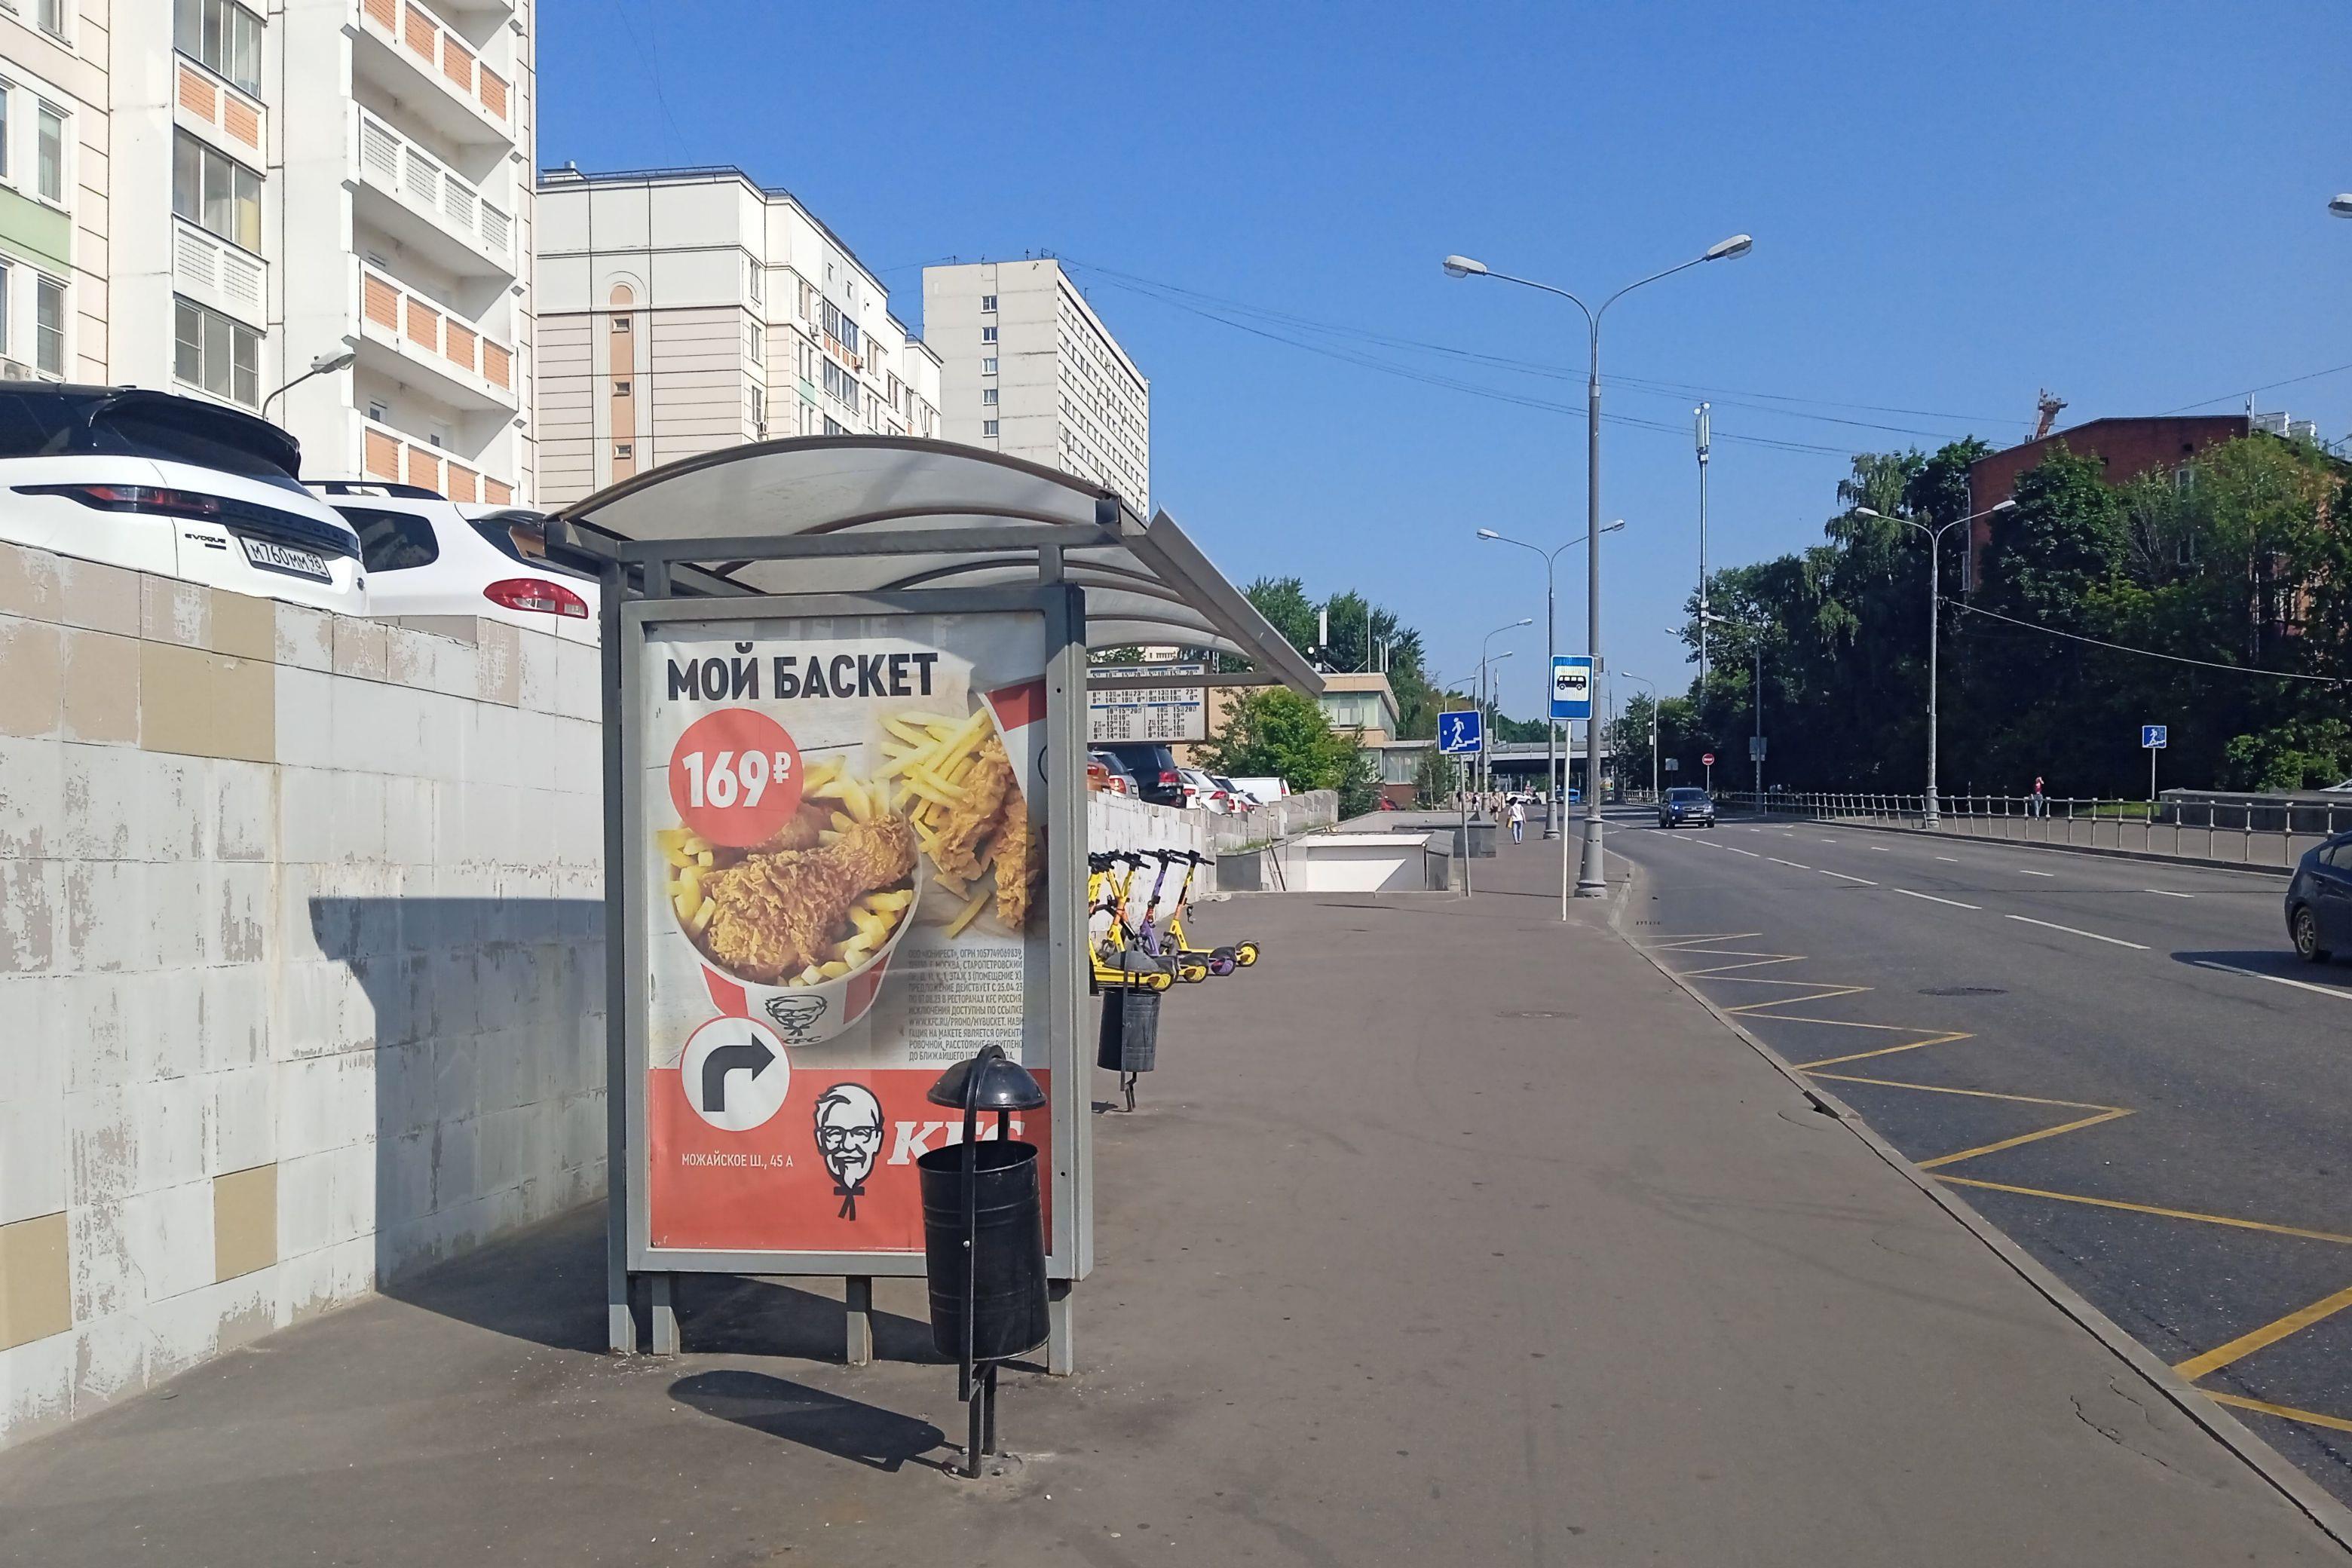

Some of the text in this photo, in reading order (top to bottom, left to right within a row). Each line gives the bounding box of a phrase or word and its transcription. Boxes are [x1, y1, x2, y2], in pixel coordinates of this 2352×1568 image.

[185, 533, 225, 544] EVOQUE
[667, 642, 939, 701] МОЙ БАСКЕТ
[960, 948, 975, 957] ОГРН
[956, 982, 991, 993] ДЕЙСТВУЕТ
[992, 983, 997, 992] С
[948, 994, 984, 1003] РЕСТОРАНАХ
[908, 1005, 1022, 1015] ИСКЛЮЧЕНИЯ ДОСТУПНЫ ПО ССЫЛКЕ
[909, 1029, 928, 1039] ГАЦИЯ
[929, 1029, 937, 1038] НА
[939, 1028, 962, 1038] МАКЕТЕ
[963, 1028, 994, 1038] ЯВЛЯЕТСЯ
[908, 1052, 918, 1062] ДО
[919, 1050, 965, 1061] БЛИЖАЙШЕГО
[681, 1150, 747, 1166] МОЖАЙСКОЕ
[770, 1155, 783, 1167] 45
[786, 1155, 794, 1167] А
